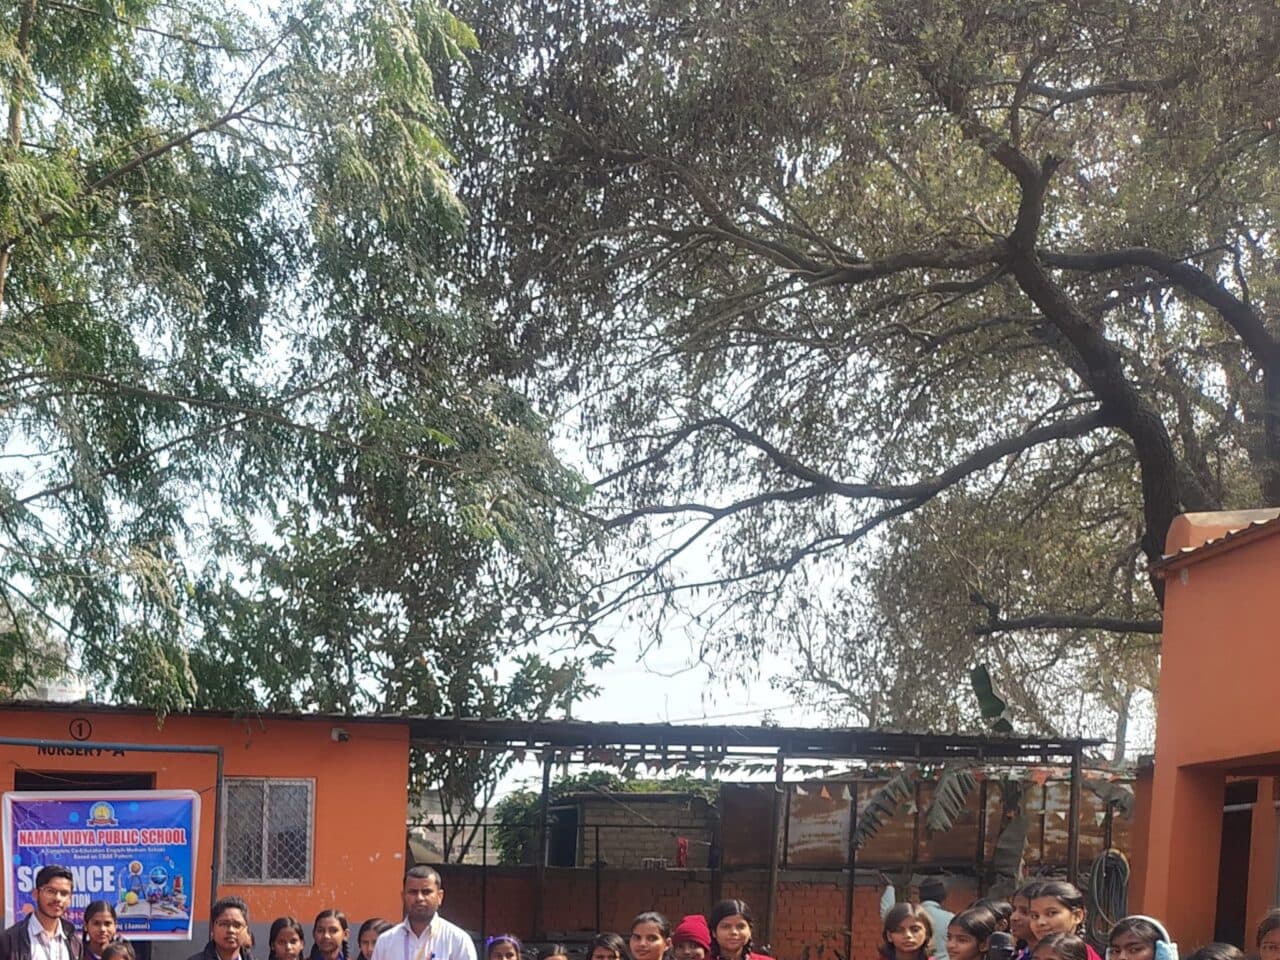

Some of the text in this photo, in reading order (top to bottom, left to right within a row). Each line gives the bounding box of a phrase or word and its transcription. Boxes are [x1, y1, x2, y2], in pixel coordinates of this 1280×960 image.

[19, 828, 186, 846] NAMAN VIDYA PUBLIC SCHOOL
